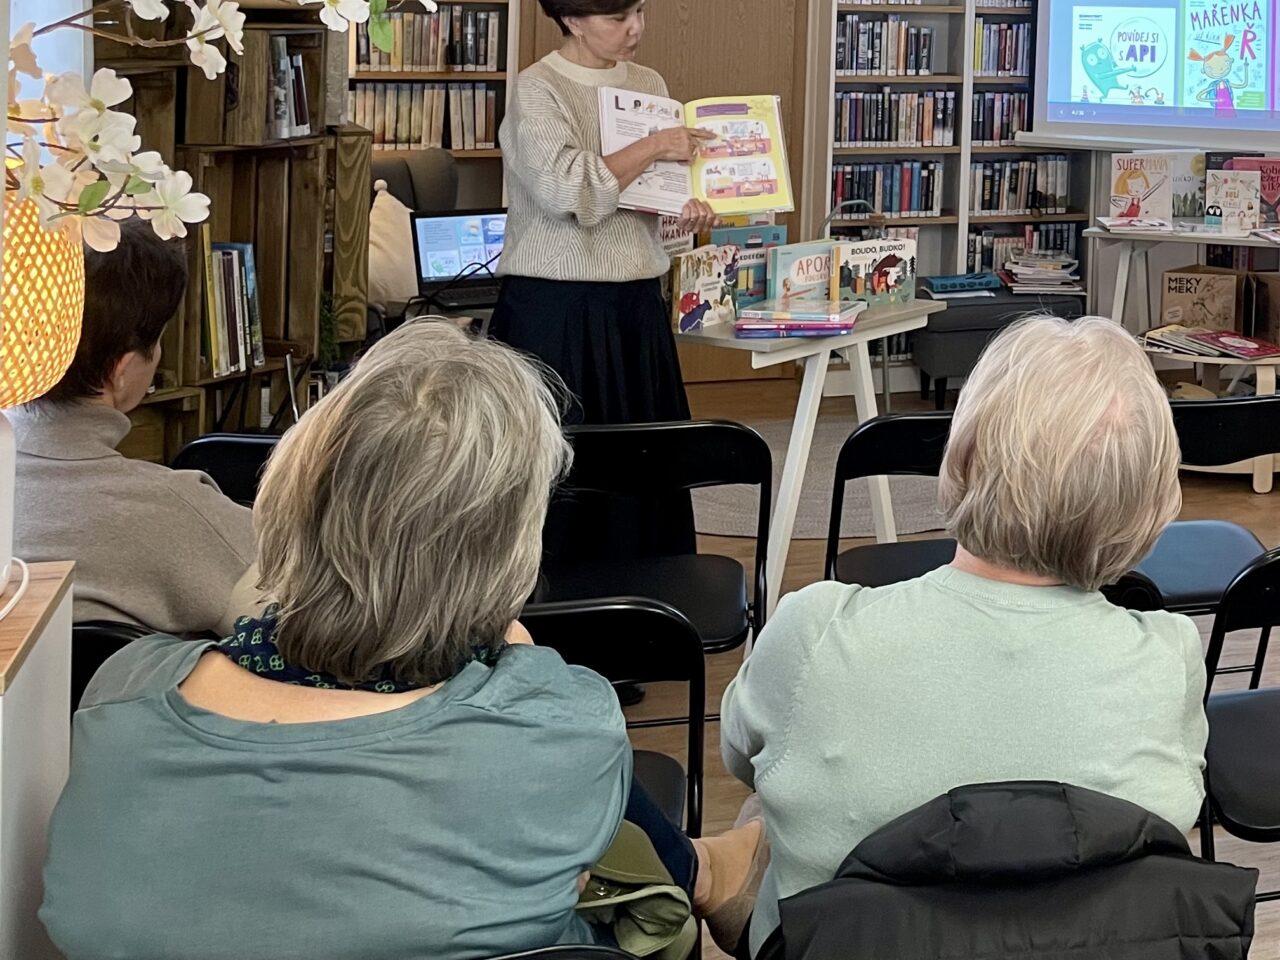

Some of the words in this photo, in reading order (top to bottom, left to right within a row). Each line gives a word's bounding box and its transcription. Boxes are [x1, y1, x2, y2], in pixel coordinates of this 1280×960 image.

[1191, 1, 1262, 31] MAŘENKA
[1118, 29, 1149, 42] POVÍDEJ
[1151, 33, 1159, 43] SI
[1240, 22, 1257, 60] Ř
[1126, 45, 1156, 63] API
[1262, 182, 1280, 191] vlk?
[662, 216, 681, 226] HRA
[851, 247, 878, 256] BOUDO,
[880, 244, 906, 253] BUDKO!
[796, 256, 830, 276] APOR
[1168, 276, 1202, 286] MEKY
